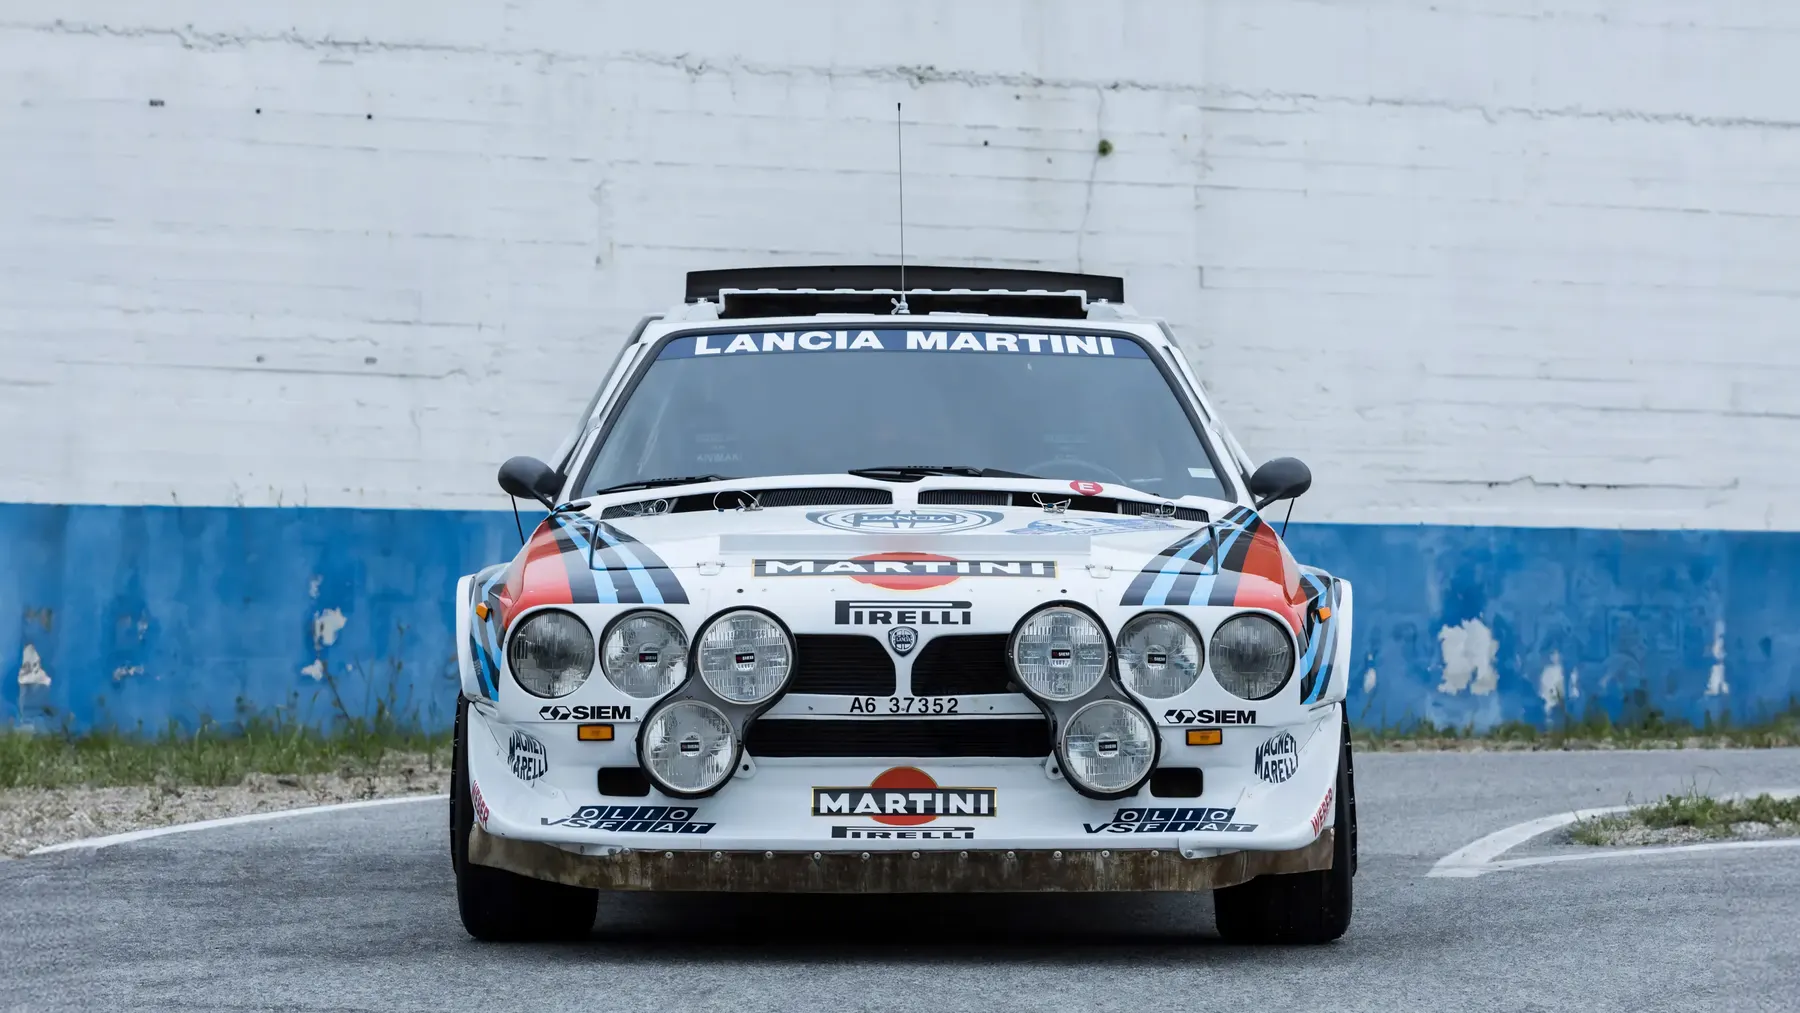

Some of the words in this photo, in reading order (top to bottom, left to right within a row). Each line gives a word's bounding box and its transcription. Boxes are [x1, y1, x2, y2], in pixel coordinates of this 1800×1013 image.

[694, 330, 885, 356] LANCIA
[906, 330, 1116, 356] MARTINI
[861, 515, 953, 523] LANCIA
[765, 560, 1045, 575] MARTINI
[834, 600, 973, 625] PIRELLI
[571, 705, 631, 720] SIEM
[849, 696, 877, 714] A6
[888, 697, 959, 714] 37352
[1196, 709, 1257, 724] SIEM
[1255, 732, 1297, 758] MAGNETI
[1254, 756, 1299, 784] MARELLI
[819, 792, 989, 814] MARTINI
[580, 807, 690, 820] OLIO
[1120, 810, 1228, 822] OLIO
[597, 822, 709, 833] FIAT
[831, 825, 976, 839] PIRELLI
[1083, 823, 1136, 834] VS
[1143, 823, 1252, 832] FIAT
